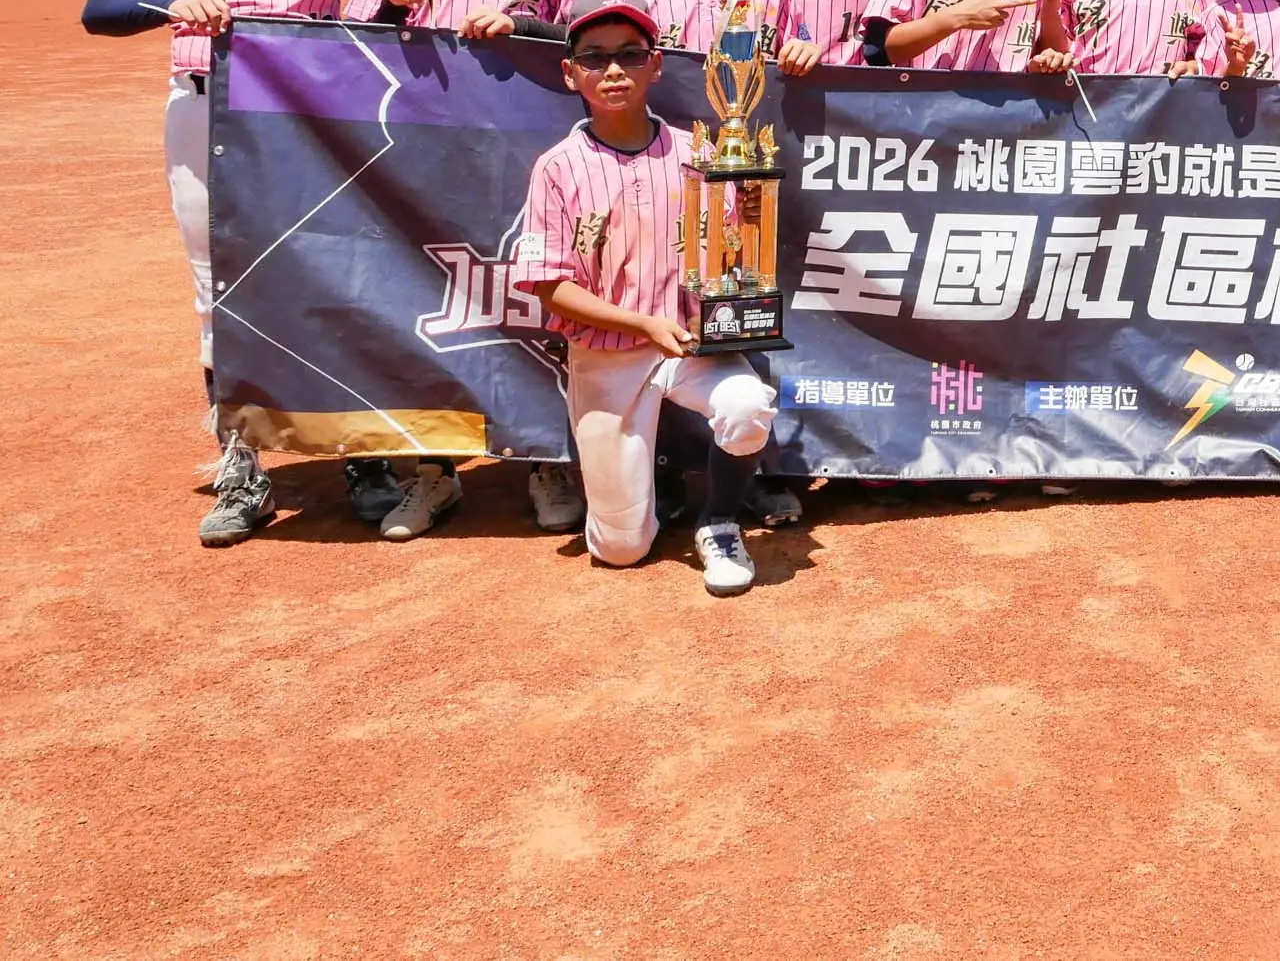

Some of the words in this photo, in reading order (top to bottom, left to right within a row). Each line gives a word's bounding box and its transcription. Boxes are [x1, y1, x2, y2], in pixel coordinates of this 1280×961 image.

[800, 134, 940, 193] 2026
[421, 249, 543, 337] JUS
[795, 379, 895, 407] 指導單位
[1039, 384, 1138, 412] 主辦單位
